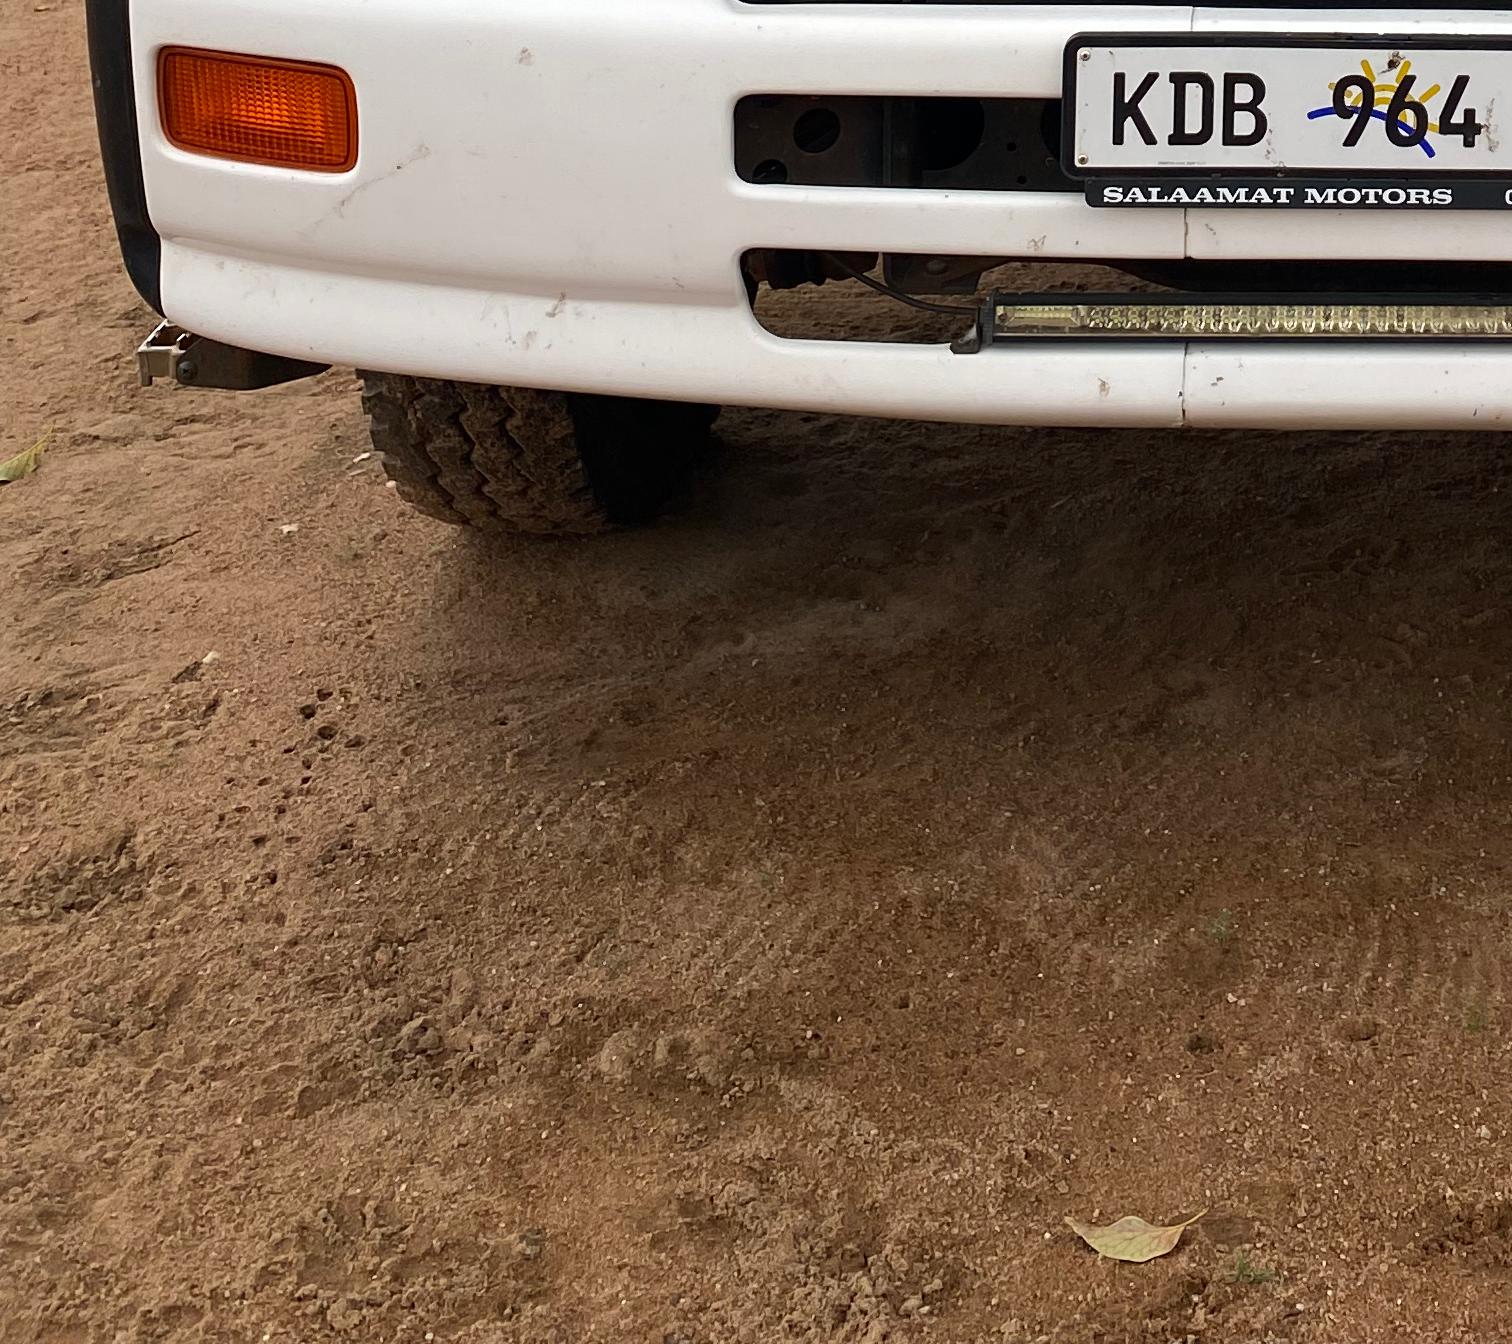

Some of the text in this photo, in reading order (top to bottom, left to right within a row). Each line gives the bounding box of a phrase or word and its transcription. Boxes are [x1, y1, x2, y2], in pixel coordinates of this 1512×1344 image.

[1112, 71, 1268, 147] KDB
[1333, 74, 1482, 148] 964
[1103, 186, 1295, 204] SALAAMAT
[1304, 187, 1453, 205] MOTORS
